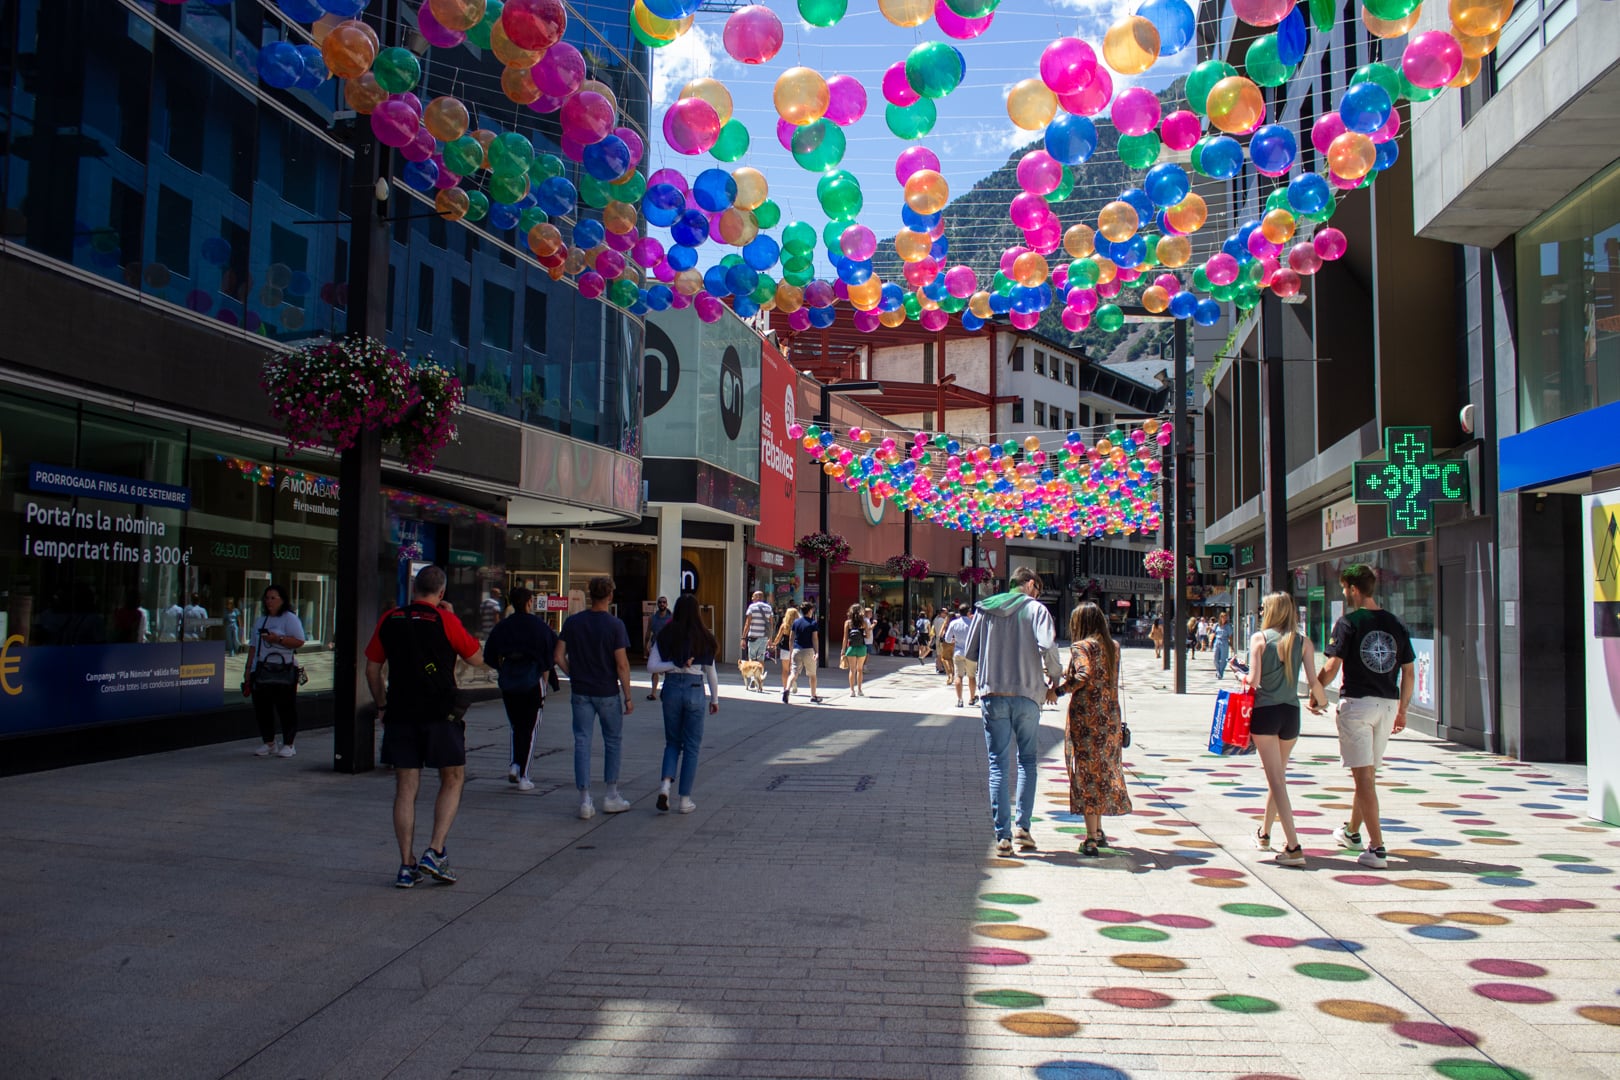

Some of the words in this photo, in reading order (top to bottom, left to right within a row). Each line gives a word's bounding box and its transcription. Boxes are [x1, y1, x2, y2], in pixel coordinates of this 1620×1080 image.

[762, 403, 772, 429] Les
[761, 432, 794, 481] rebaixes
[35, 470, 97, 491] PRORROGADA
[99, 480, 118, 493] FINS
[118, 484, 129, 496] AL
[130, 485, 136, 496] 6
[137, 486, 149, 498] DE
[149, 488, 186, 504] SETEMBRE
[26, 502, 94, 529] Porta'ns
[97, 509, 112, 532] la
[115, 513, 166, 537] nòmina
[24, 534, 30, 557] i
[112, 541, 140, 563] fins
[142, 548, 151, 564] a
